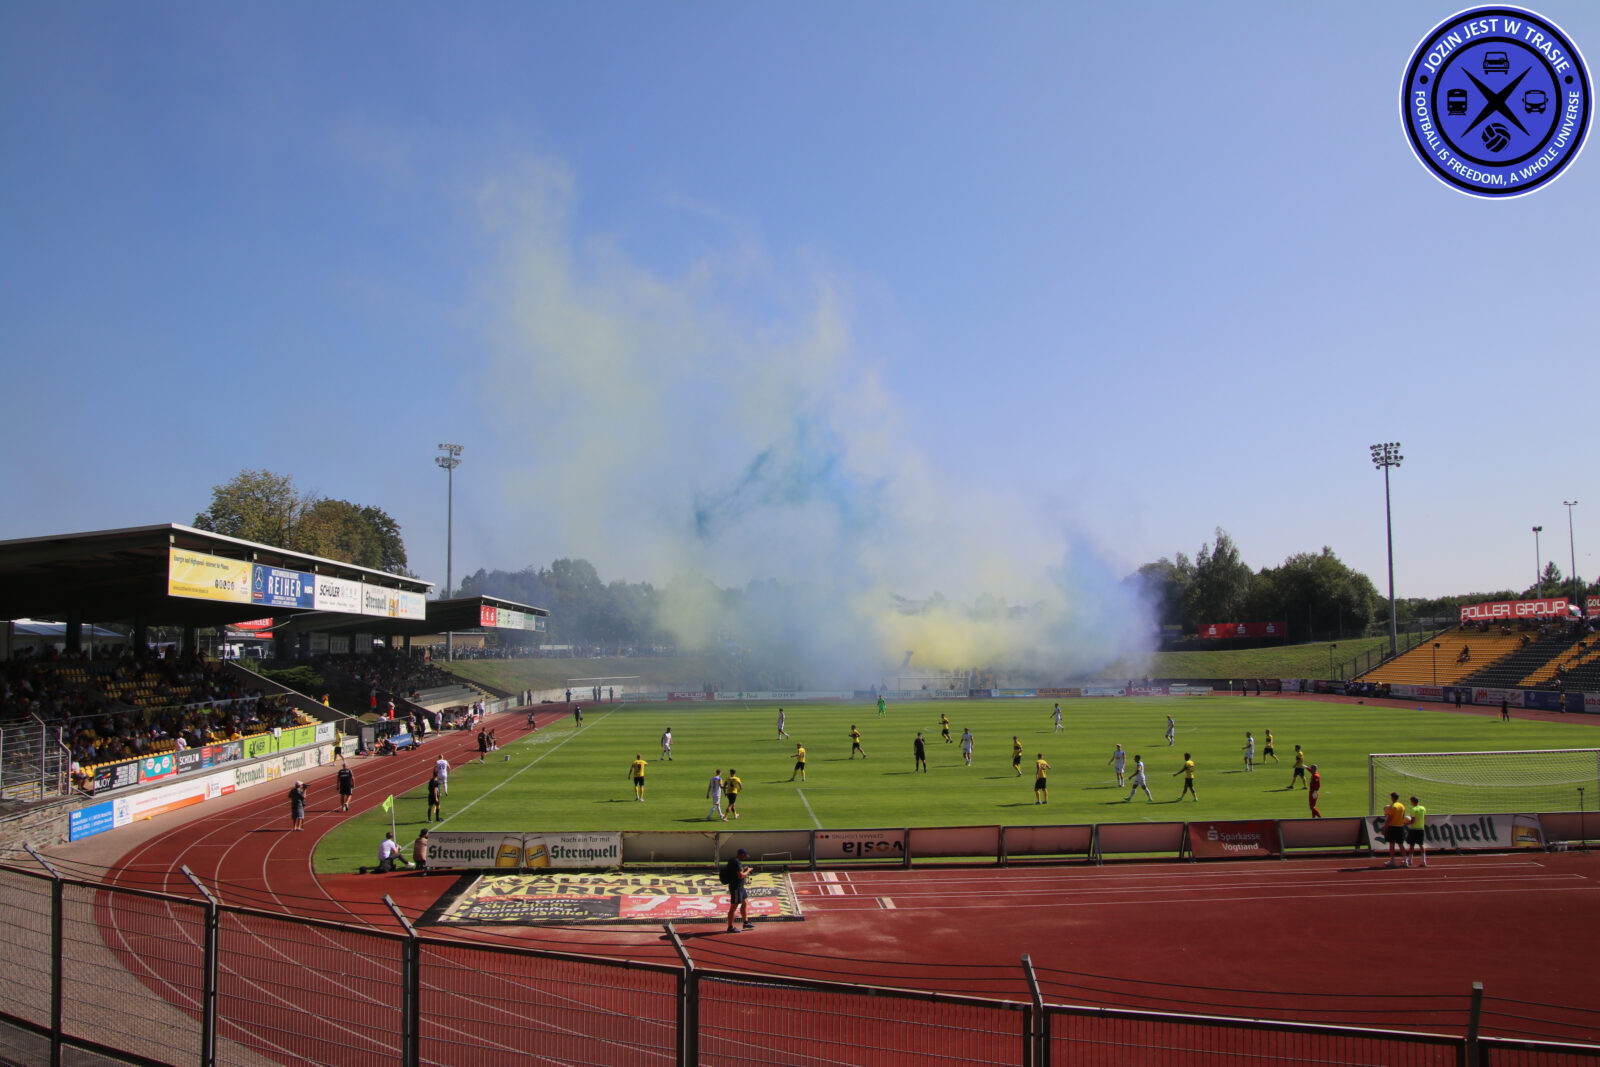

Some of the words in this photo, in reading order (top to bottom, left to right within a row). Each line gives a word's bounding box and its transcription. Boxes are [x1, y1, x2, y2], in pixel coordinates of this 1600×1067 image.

[268, 576, 301, 597] REIHER
[320, 582, 340, 597] SCHÜLER
[1461, 603, 1510, 618] POLLER
[1515, 600, 1566, 616] GROUP
[235, 763, 264, 786] Sternquell
[1220, 832, 1260, 841] Sparkasse
[1372, 816, 1498, 847] Snquell
[438, 836, 456, 844] Gutes
[458, 837, 473, 845] Spiel
[842, 840, 904, 857] vosla
[1222, 843, 1259, 852] Vogtland
[427, 844, 495, 862] Sternquell
[550, 844, 617, 861] Sternquell
